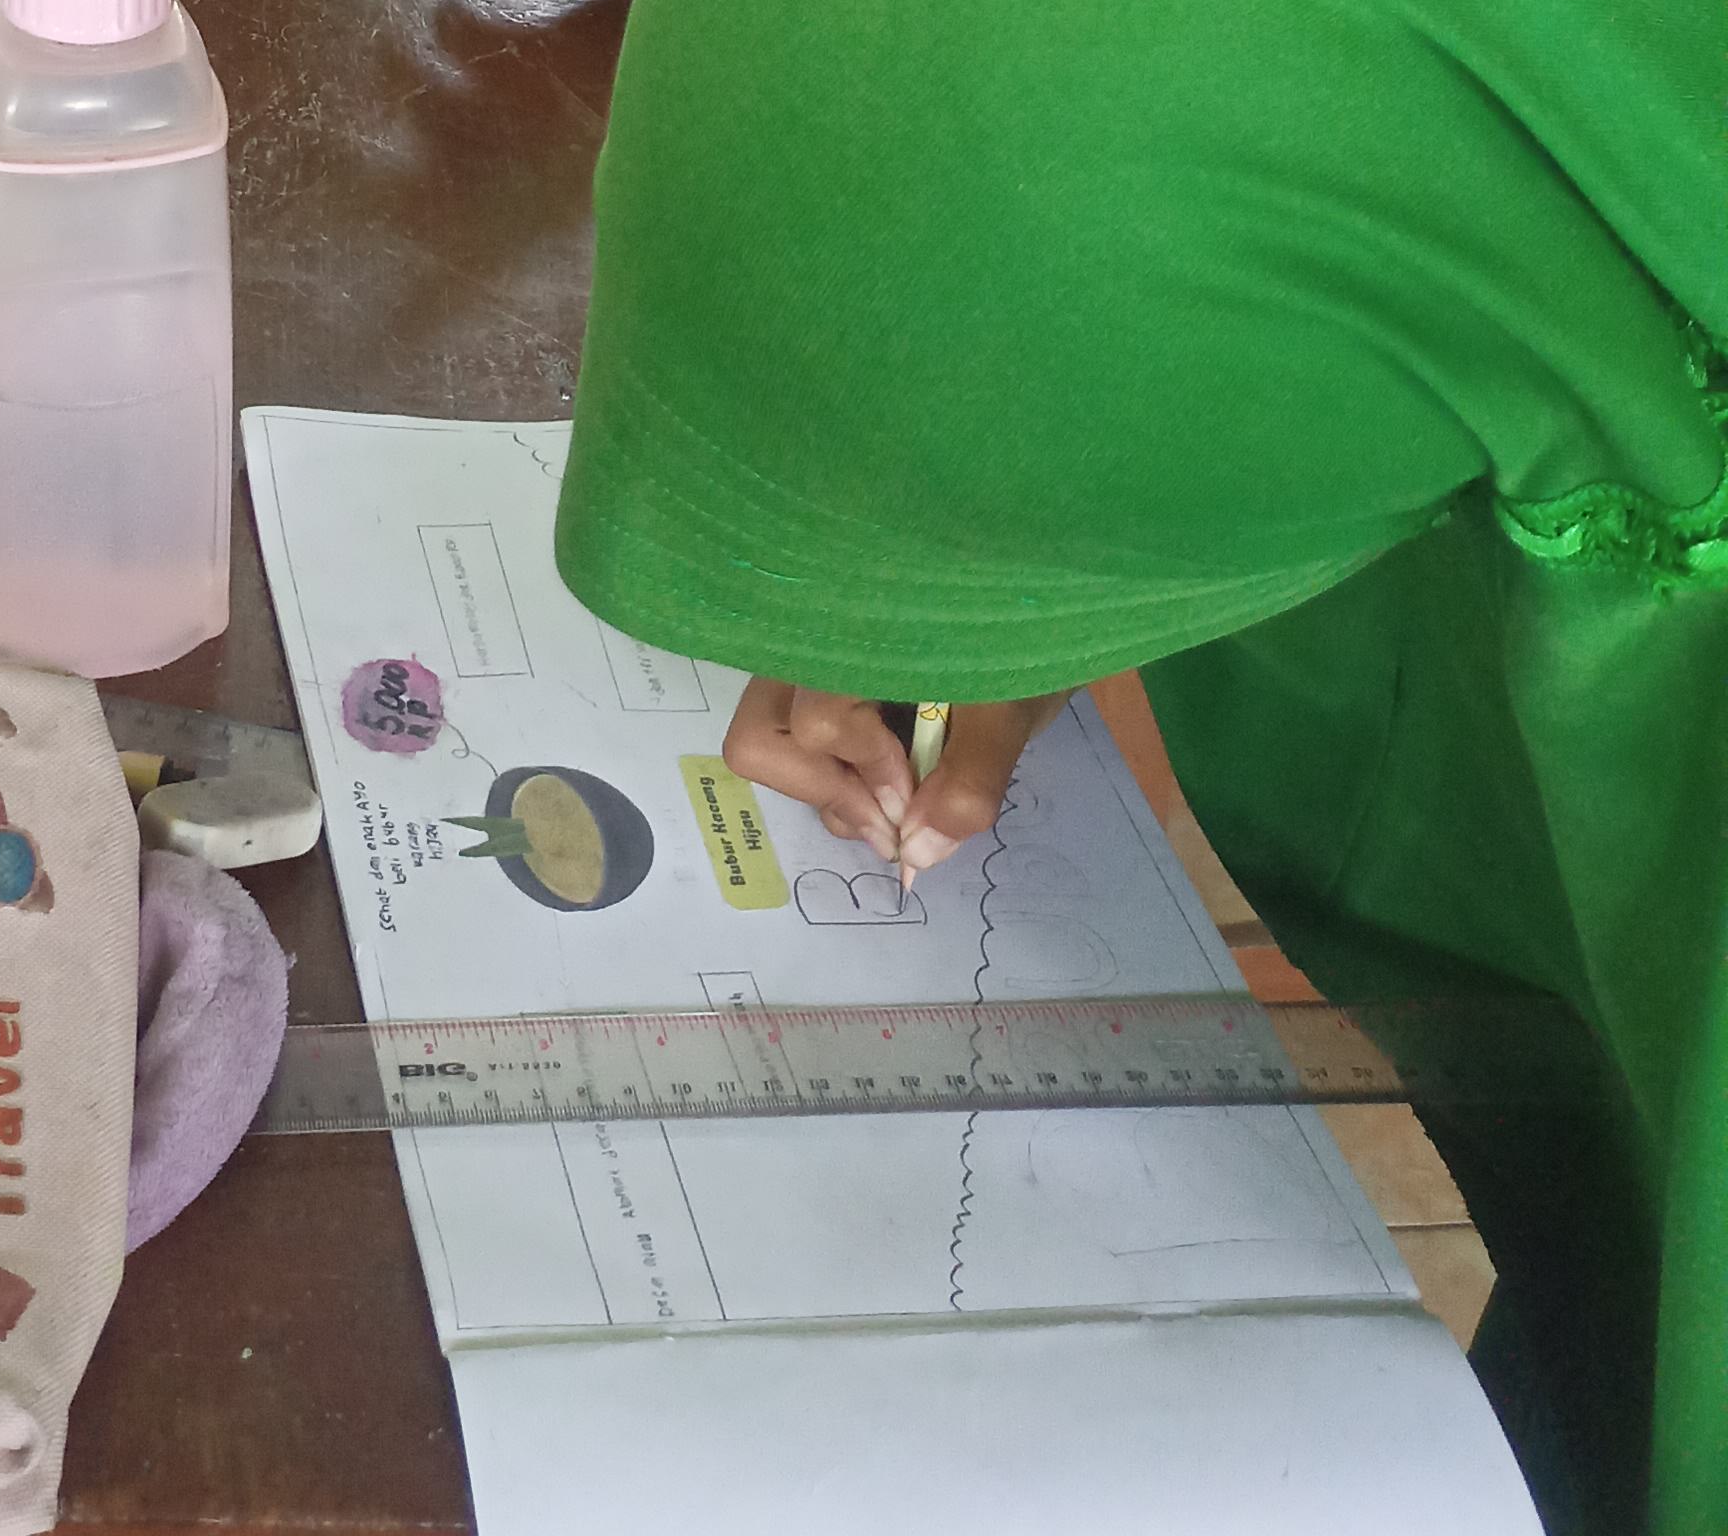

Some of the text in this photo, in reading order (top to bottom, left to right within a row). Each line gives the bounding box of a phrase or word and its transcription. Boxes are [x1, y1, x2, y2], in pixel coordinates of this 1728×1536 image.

[699, 775, 747, 887] Bubur Kacang
[739, 809, 763, 851] Hijau
